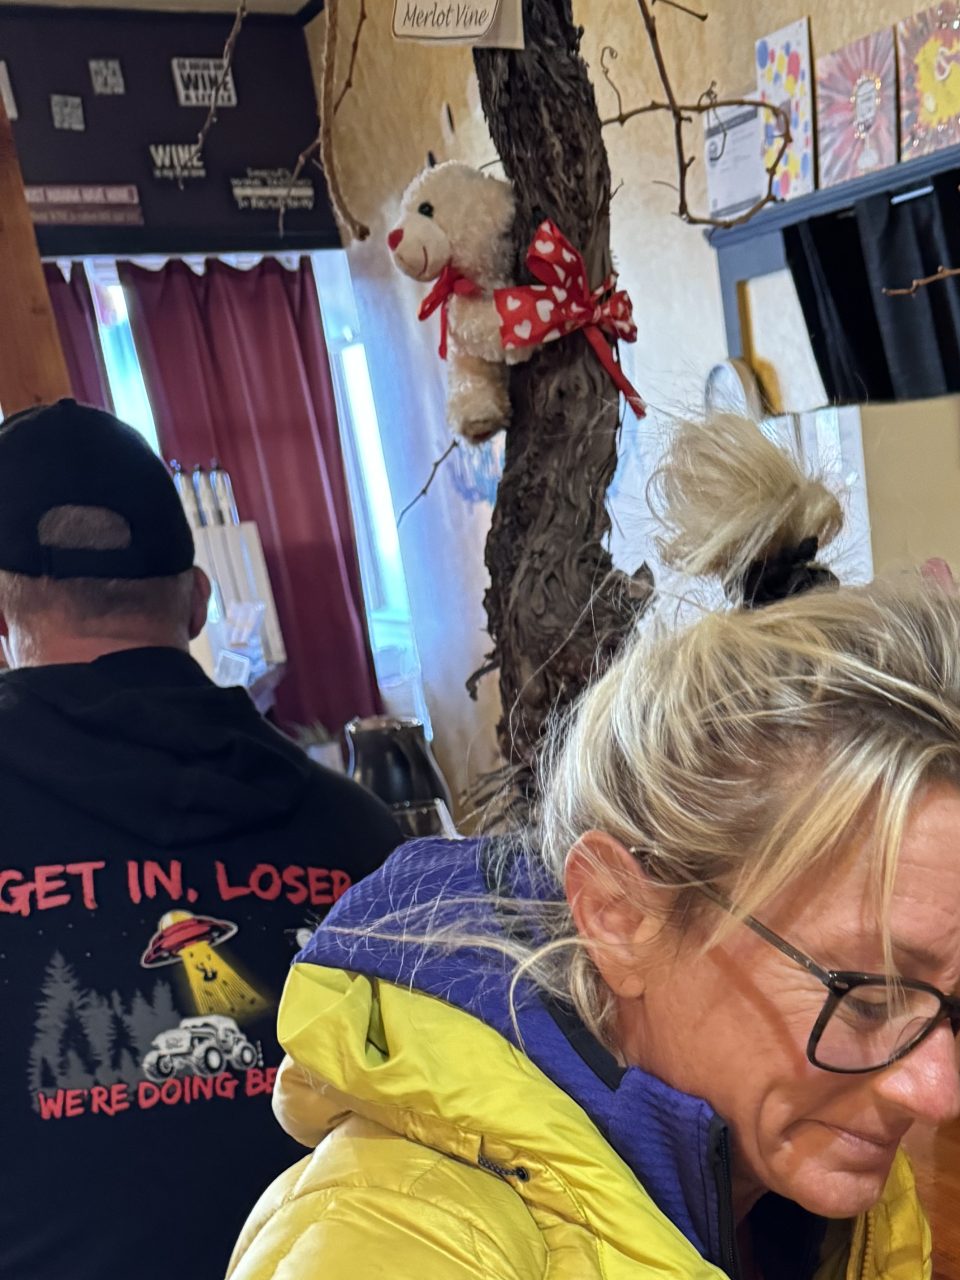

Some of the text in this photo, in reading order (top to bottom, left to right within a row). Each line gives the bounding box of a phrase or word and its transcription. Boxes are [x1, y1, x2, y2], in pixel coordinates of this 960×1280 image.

[401, 1, 490, 29] Merlot Vine
[149, 144, 204, 168] WINE
[0, 861, 106, 917] GET
[38, 1083, 131, 1121] WE'RE
[138, 1072, 239, 1107] DOING
